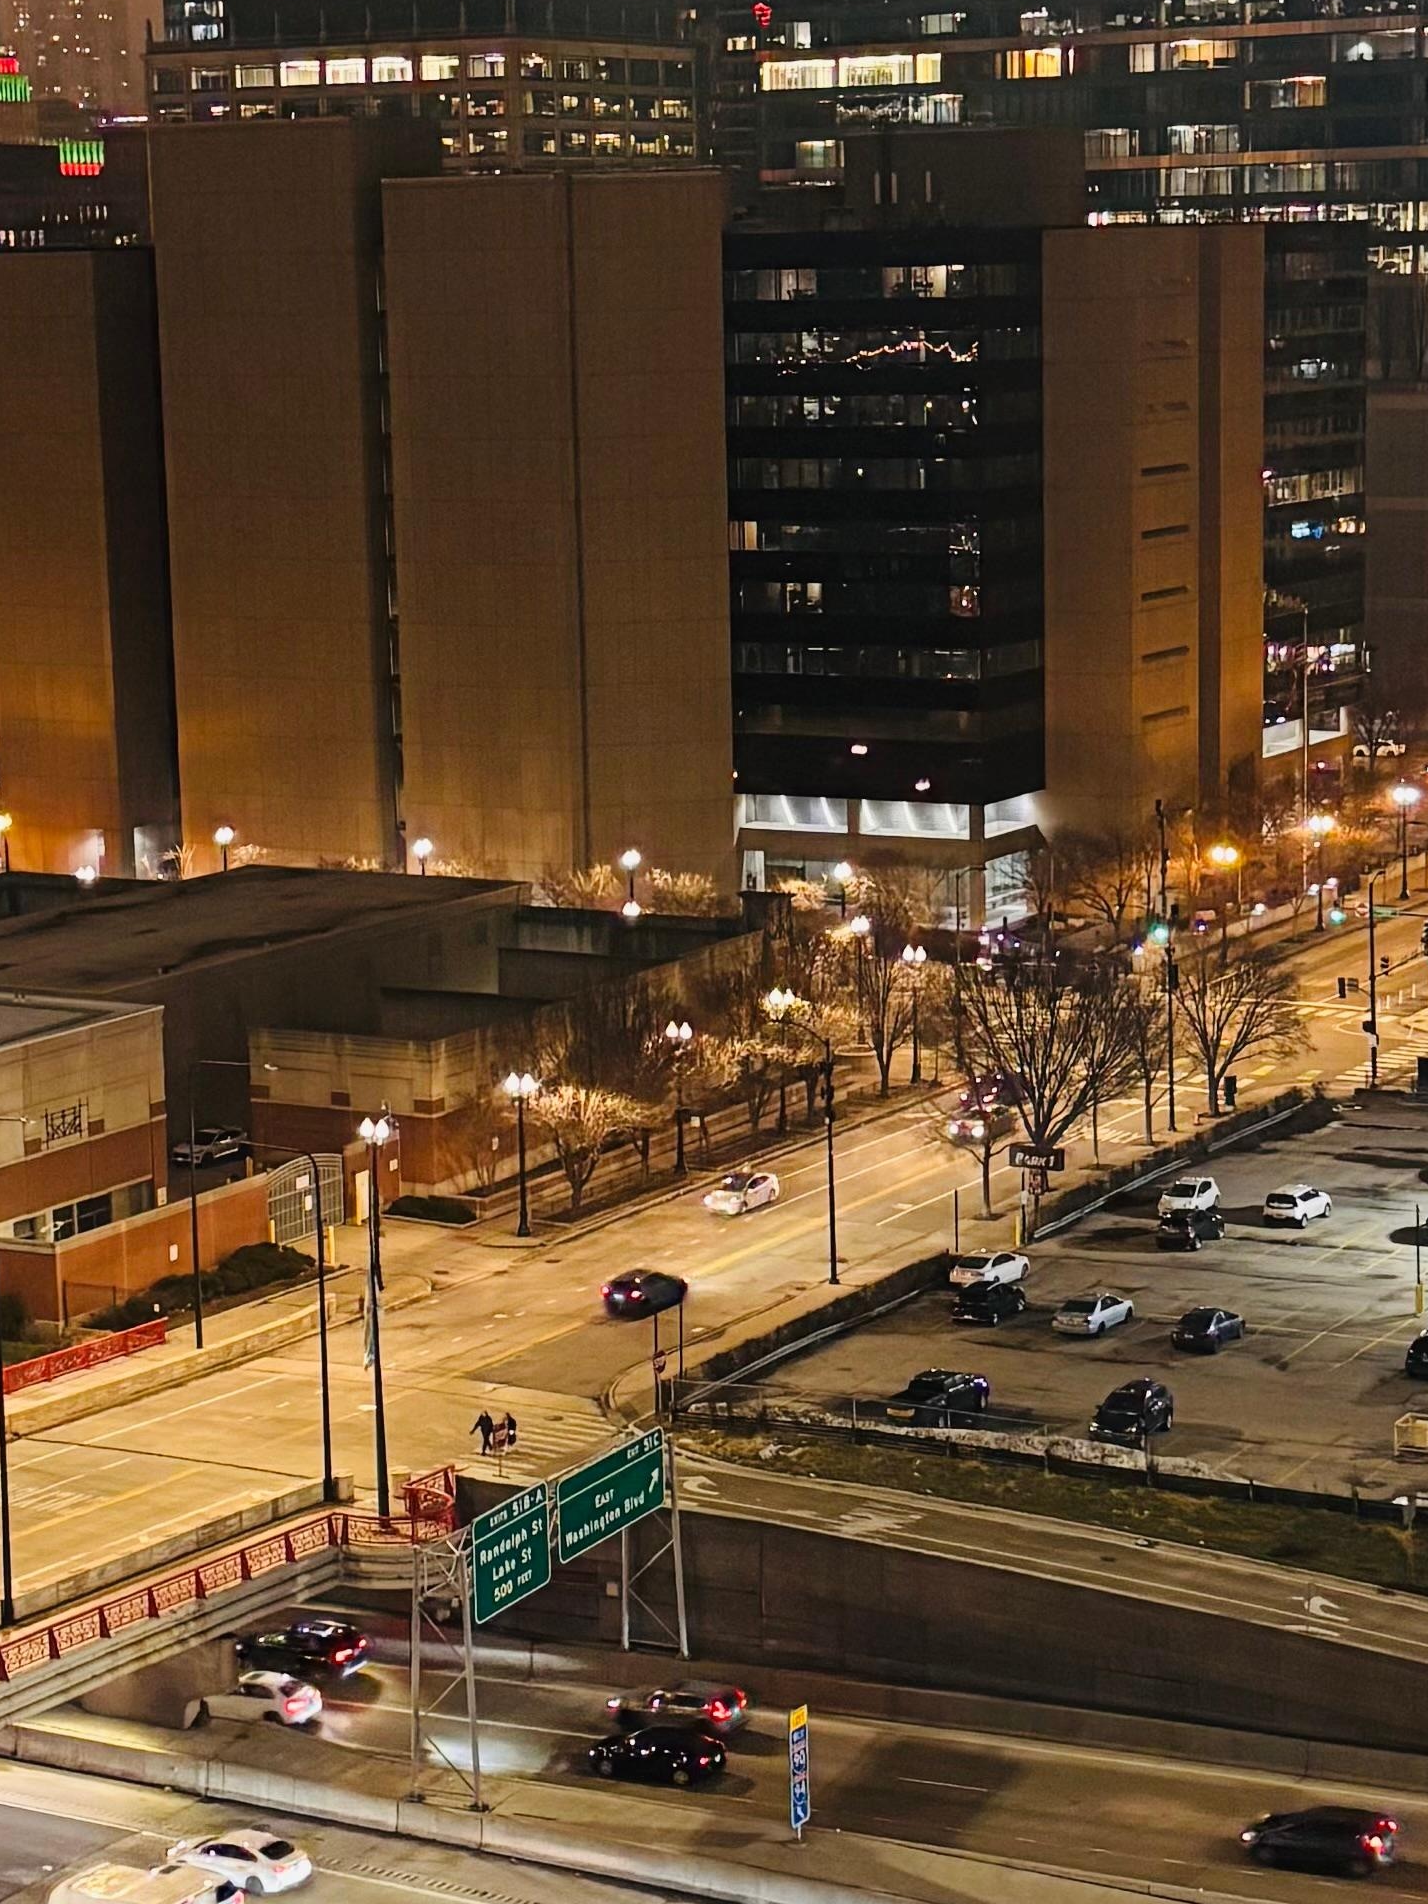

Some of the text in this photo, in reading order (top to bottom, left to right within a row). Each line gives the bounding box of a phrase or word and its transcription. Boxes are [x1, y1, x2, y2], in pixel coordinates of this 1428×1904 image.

[594, 1489, 614, 1508] EAST
[565, 1492, 645, 1547] Washington Blvd
[479, 1518, 543, 1567] Randolph St
[492, 1547, 532, 1581] Lake St
[494, 1571, 532, 1602] 500 FEET
